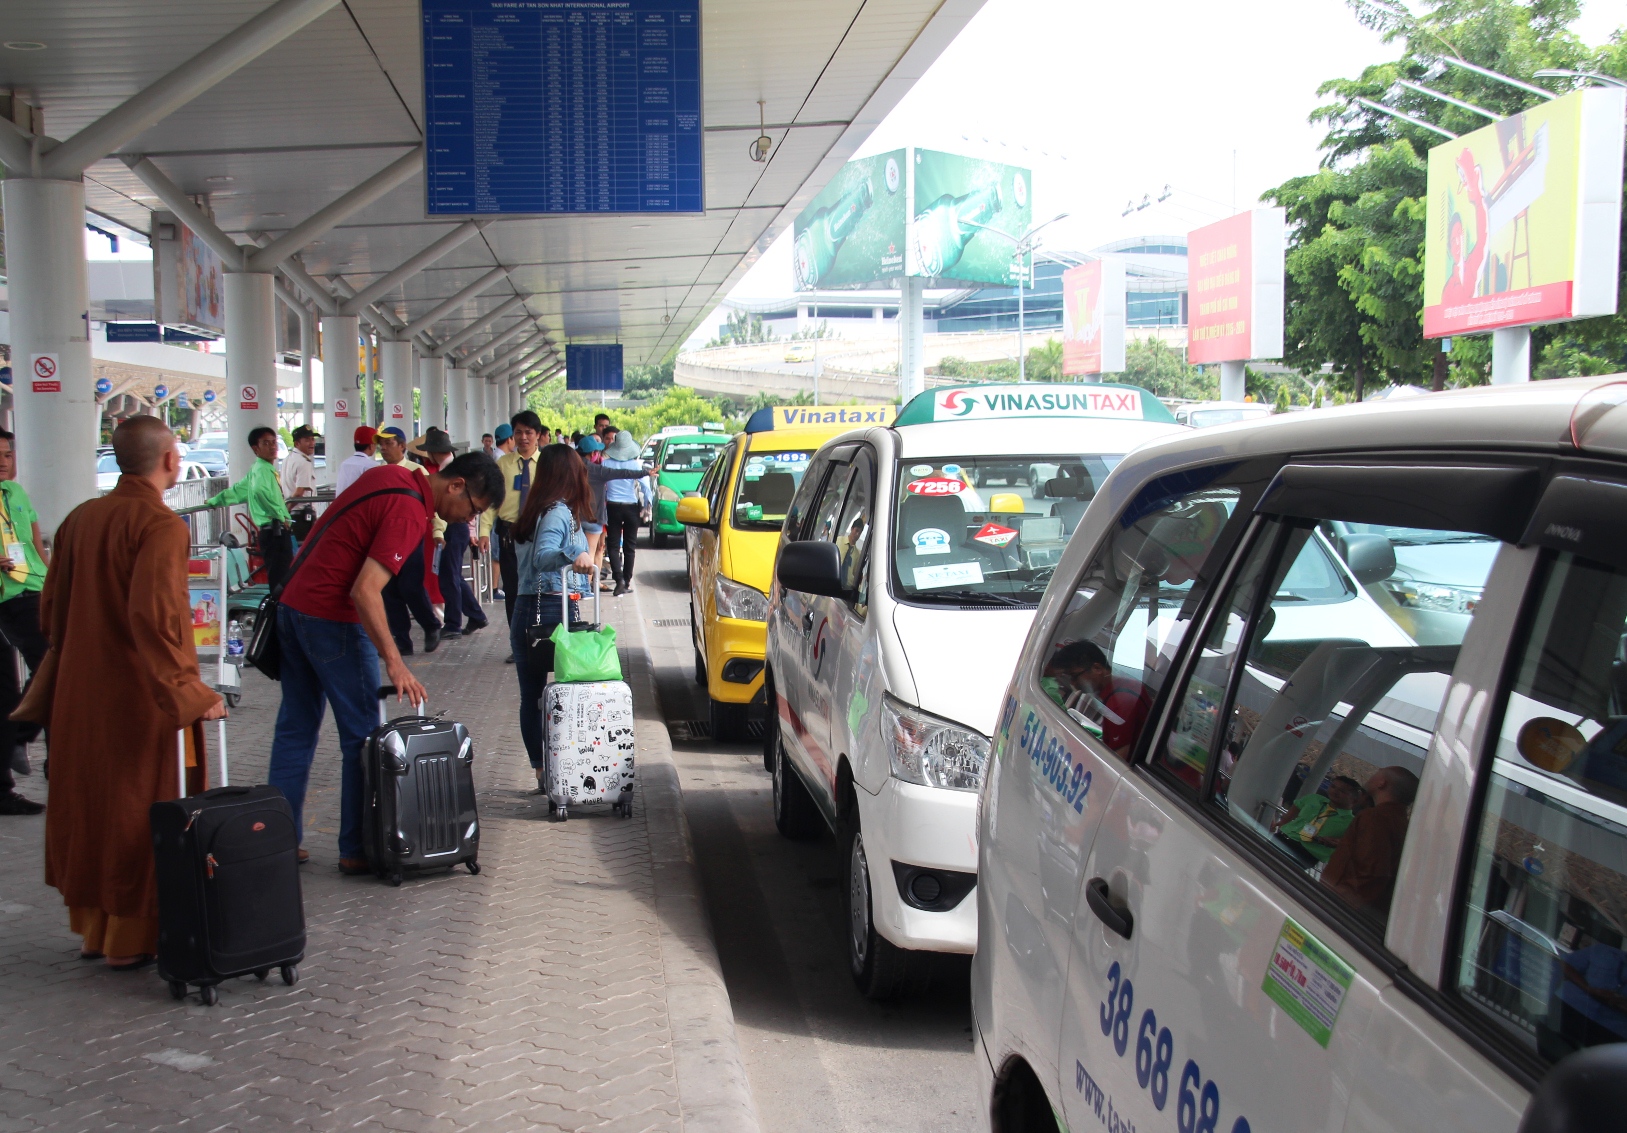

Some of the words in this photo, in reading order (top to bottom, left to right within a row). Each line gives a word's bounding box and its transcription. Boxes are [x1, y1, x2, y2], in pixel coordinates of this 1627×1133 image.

[783, 408, 886, 424] Vinataxi
[776, 454, 806, 462] 1693
[912, 480, 961, 494] 7256
[1100, 960, 1133, 1058] 38
[1136, 1008, 1172, 1111] 68
[1177, 1058, 1219, 1133] 68
